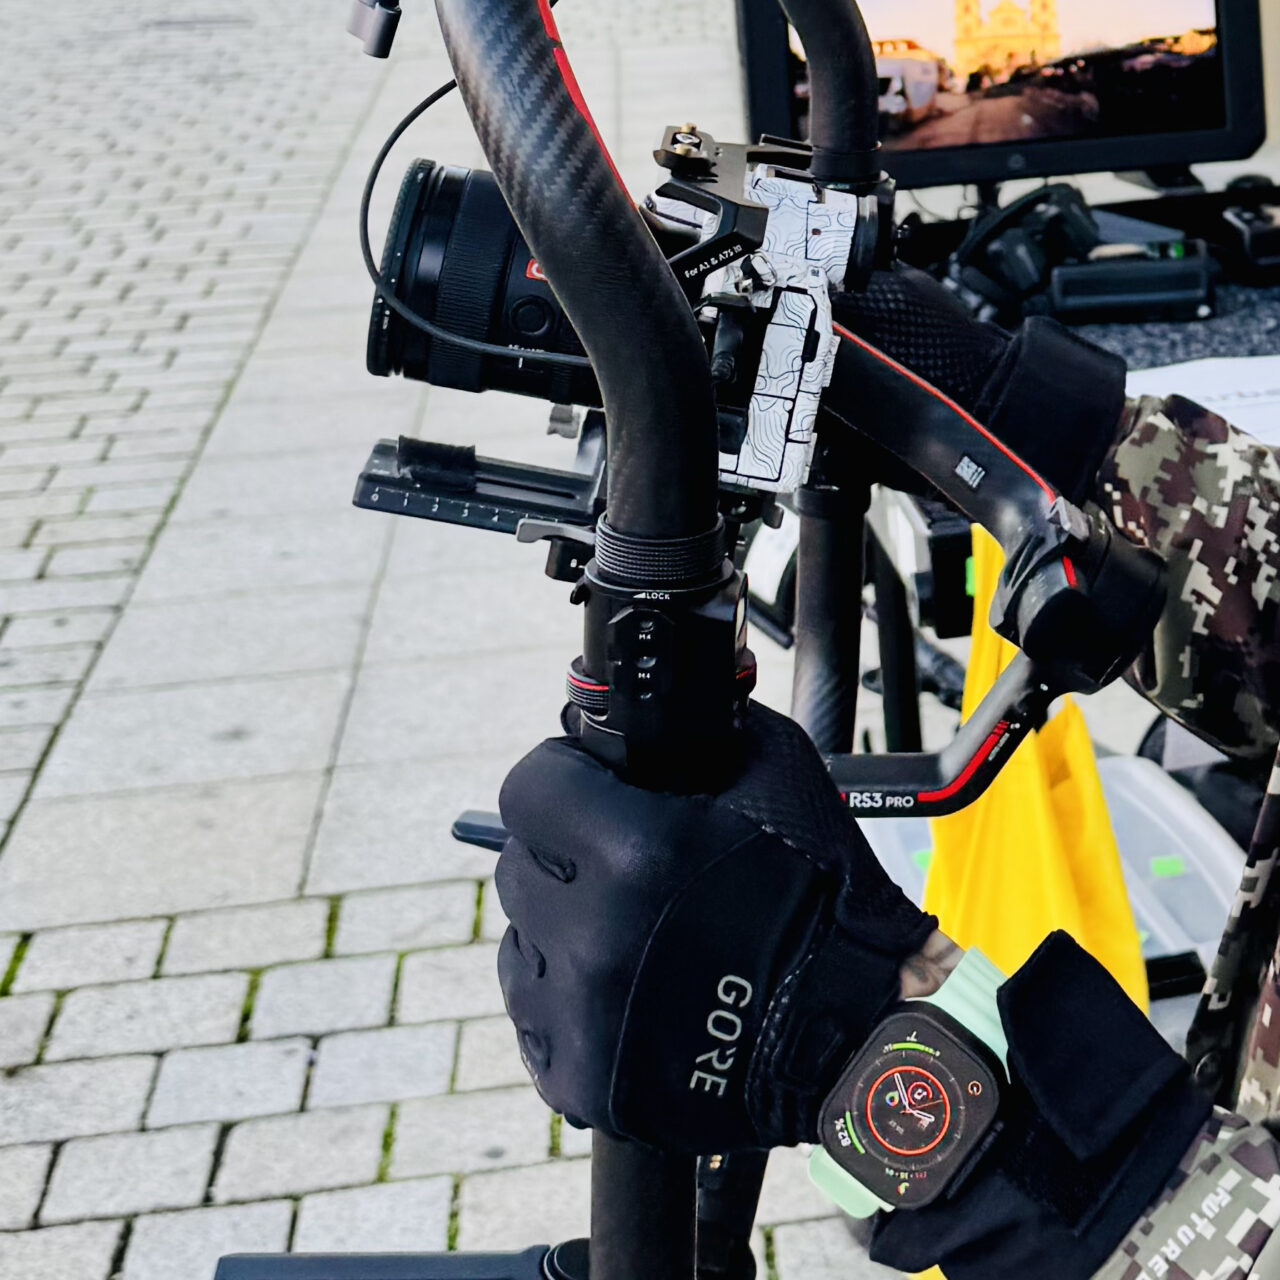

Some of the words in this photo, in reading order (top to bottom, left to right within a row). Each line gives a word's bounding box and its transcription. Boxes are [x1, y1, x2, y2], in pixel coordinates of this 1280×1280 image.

[646, 592, 670, 600] LOCK
[849, 792, 883, 808] RS3
[885, 796, 914, 808] PRO
[689, 974, 753, 1097] GORE
